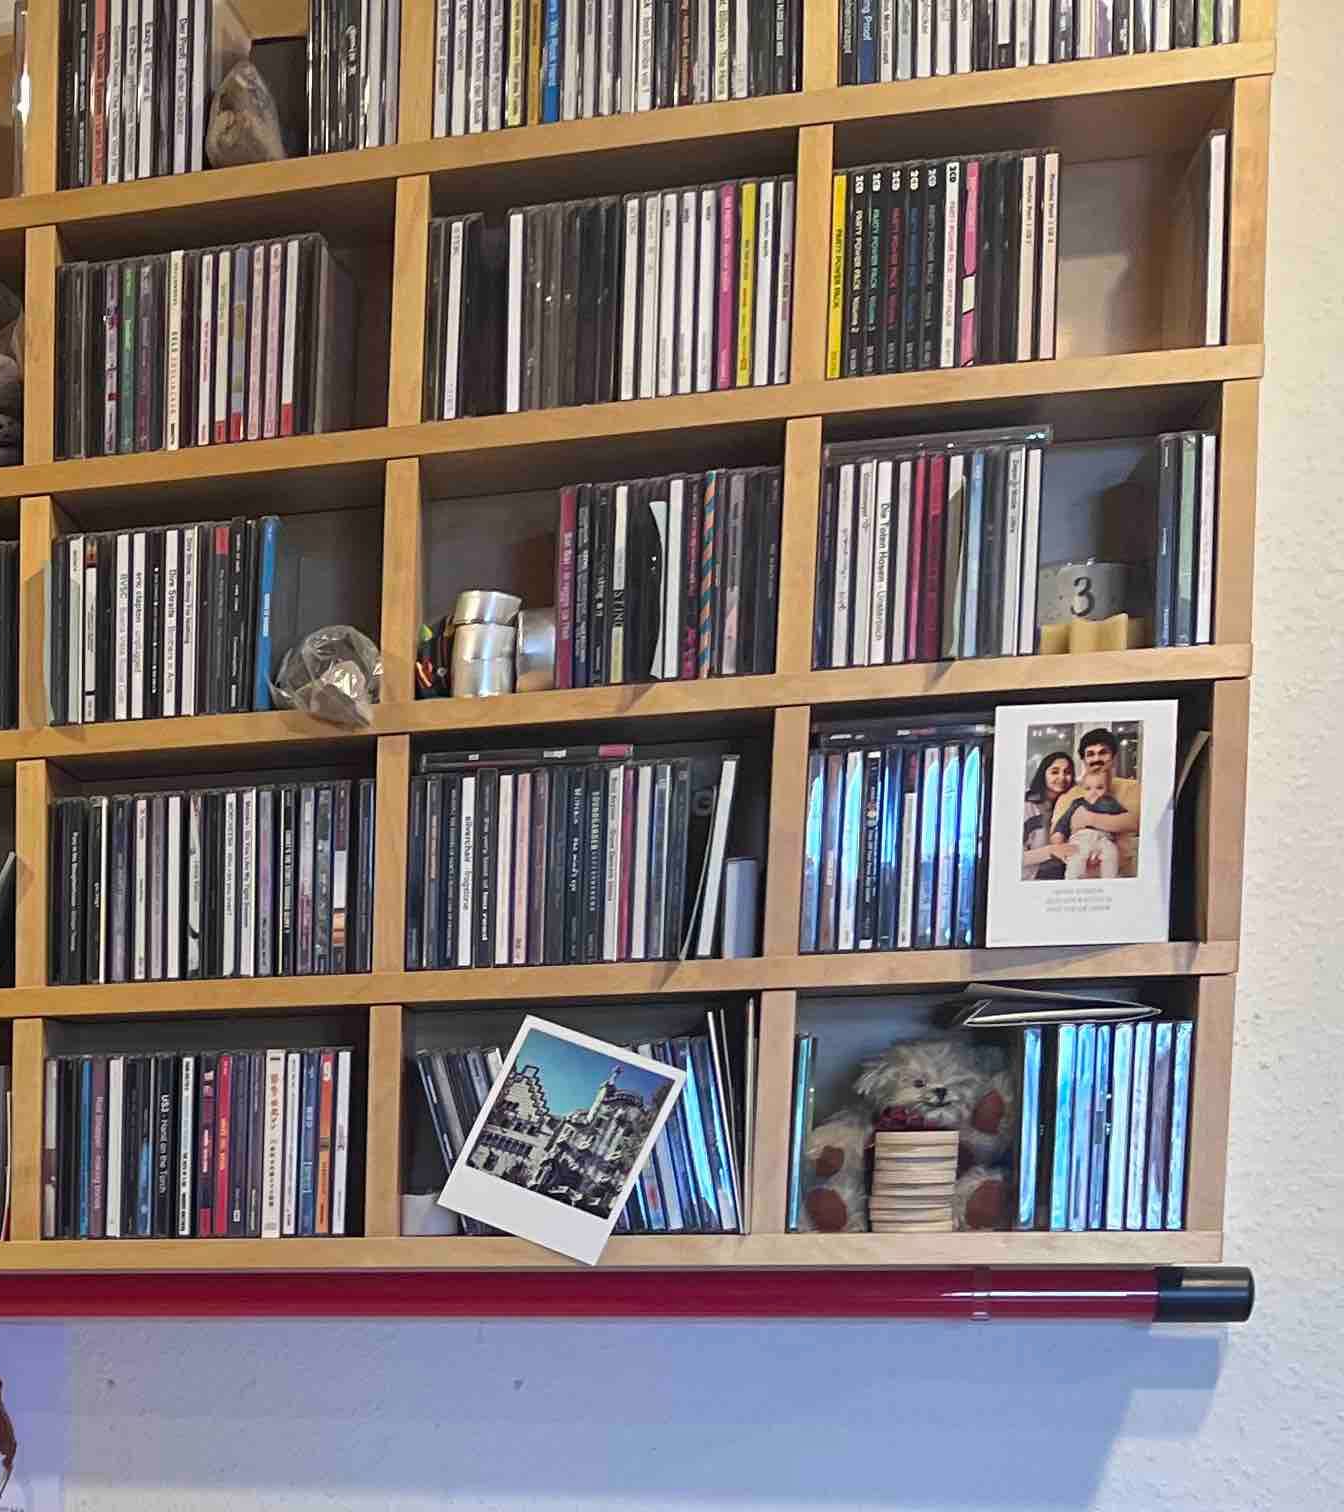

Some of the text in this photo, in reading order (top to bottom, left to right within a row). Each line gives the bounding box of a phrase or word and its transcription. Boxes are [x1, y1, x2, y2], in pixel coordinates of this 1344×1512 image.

[872, 173, 880, 192] 2CD
[892, 171, 900, 191] 2CD
[910, 170, 919, 190] 2CD
[928, 169, 936, 187] 2CD
[949, 165, 957, 182] 2CD
[872, 209, 880, 234] PARTY
[835, 229, 843, 253] PARTY
[854, 237, 862, 266] POWER
[871, 236, 879, 265] POWER
[834, 255, 842, 286] POWER
[853, 269, 861, 290] PACK
[870, 267, 878, 288] PACK
[881, 503, 889, 520] Die
[879, 522, 889, 549] Toten
[168, 569, 177, 587] Dire
[878, 551, 887, 583] Hosen
[133, 591, 143, 623] clapton
[167, 589, 176, 618] Straits
[1070, 576, 1095, 617] 3
[464, 816, 472, 863] silverchair
